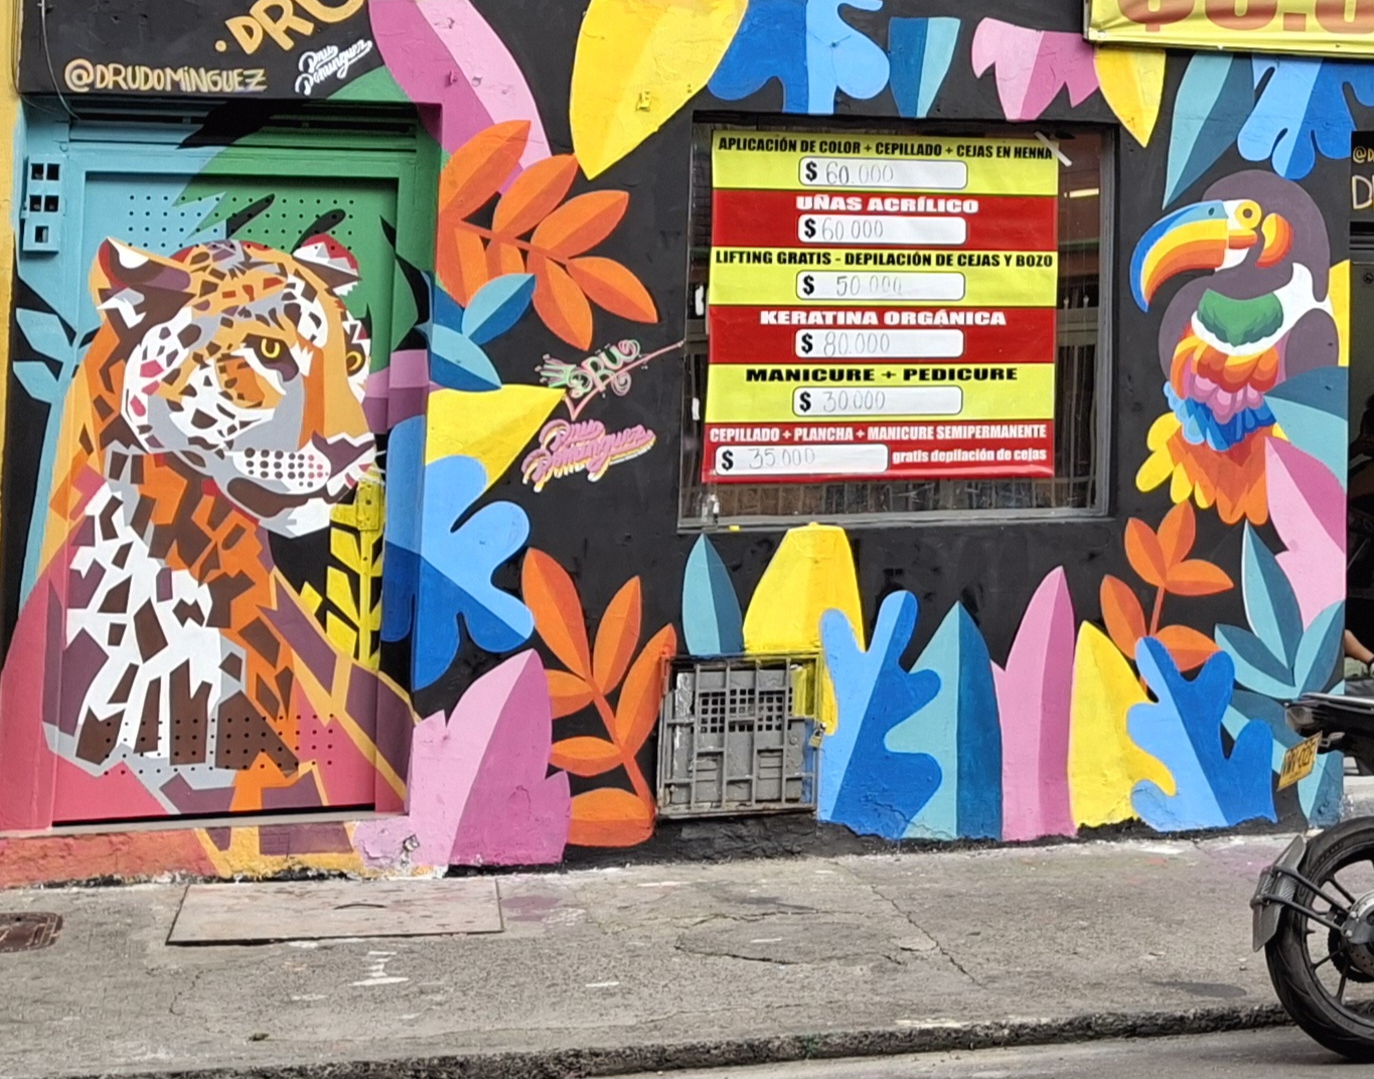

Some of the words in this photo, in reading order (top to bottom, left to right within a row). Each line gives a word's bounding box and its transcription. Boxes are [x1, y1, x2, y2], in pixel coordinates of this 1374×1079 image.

[718, 136, 797, 153] APLICACIÓN
[801, 141, 817, 153] DE
[819, 141, 861, 154] COLOR
[876, 143, 942, 157] CEPILLADO
[957, 145, 993, 158] CEJAS
[996, 146, 1010, 158] EN
[1014, 146, 1052, 160] HENNA
[796, 195, 863, 211] UÑAS
[867, 196, 979, 213] ACRÍLICO
[715, 251, 774, 265] LIFTING
[777, 251, 832, 265] GRATIS
[844, 251, 932, 267] DEPILACIÓN
[936, 254, 954, 266] DE
[957, 254, 1000, 268] CEJAS
[1003, 254, 1012, 267] Y
[1015, 254, 1053, 268] BOZO
[760, 311, 878, 326] KERATINA
[884, 309, 1007, 326] ORGÁNICA
[746, 368, 875, 382] MANICURE
[903, 367, 1018, 382] PEDICURE
[709, 427, 779, 442] CEPILLADO
[794, 427, 853, 441] PLANCHA
[867, 425, 934, 441] MANICURE
[936, 424, 1046, 439] SEMIPERMANENTE
[892, 450, 929, 464] gratis
[931, 448, 995, 464] depilación
[997, 449, 1012, 461] de
[1014, 448, 1047, 462] cejas
